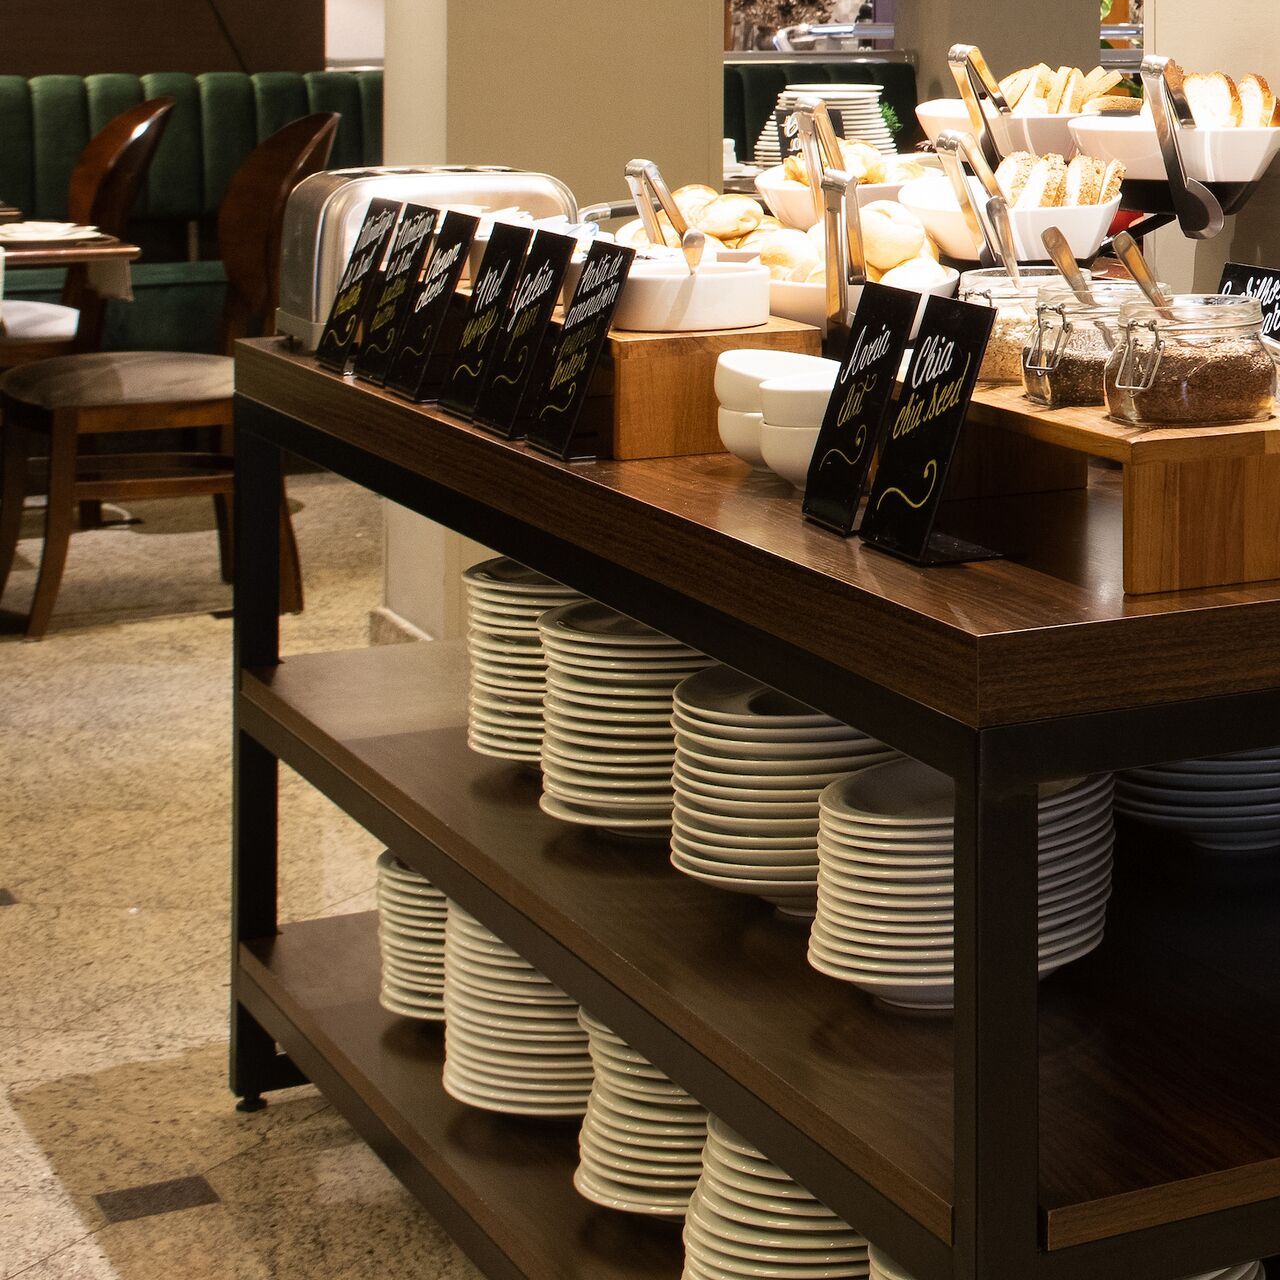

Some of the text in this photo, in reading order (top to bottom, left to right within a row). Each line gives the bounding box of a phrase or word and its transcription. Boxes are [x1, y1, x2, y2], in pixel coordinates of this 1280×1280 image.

[476, 259, 511, 313] Mel
[611, 250, 624, 277] de
[565, 280, 620, 329] amendoim
[841, 324, 891, 384] Aveia
[912, 334, 955, 389] Chia
[922, 352, 971, 422] seed
